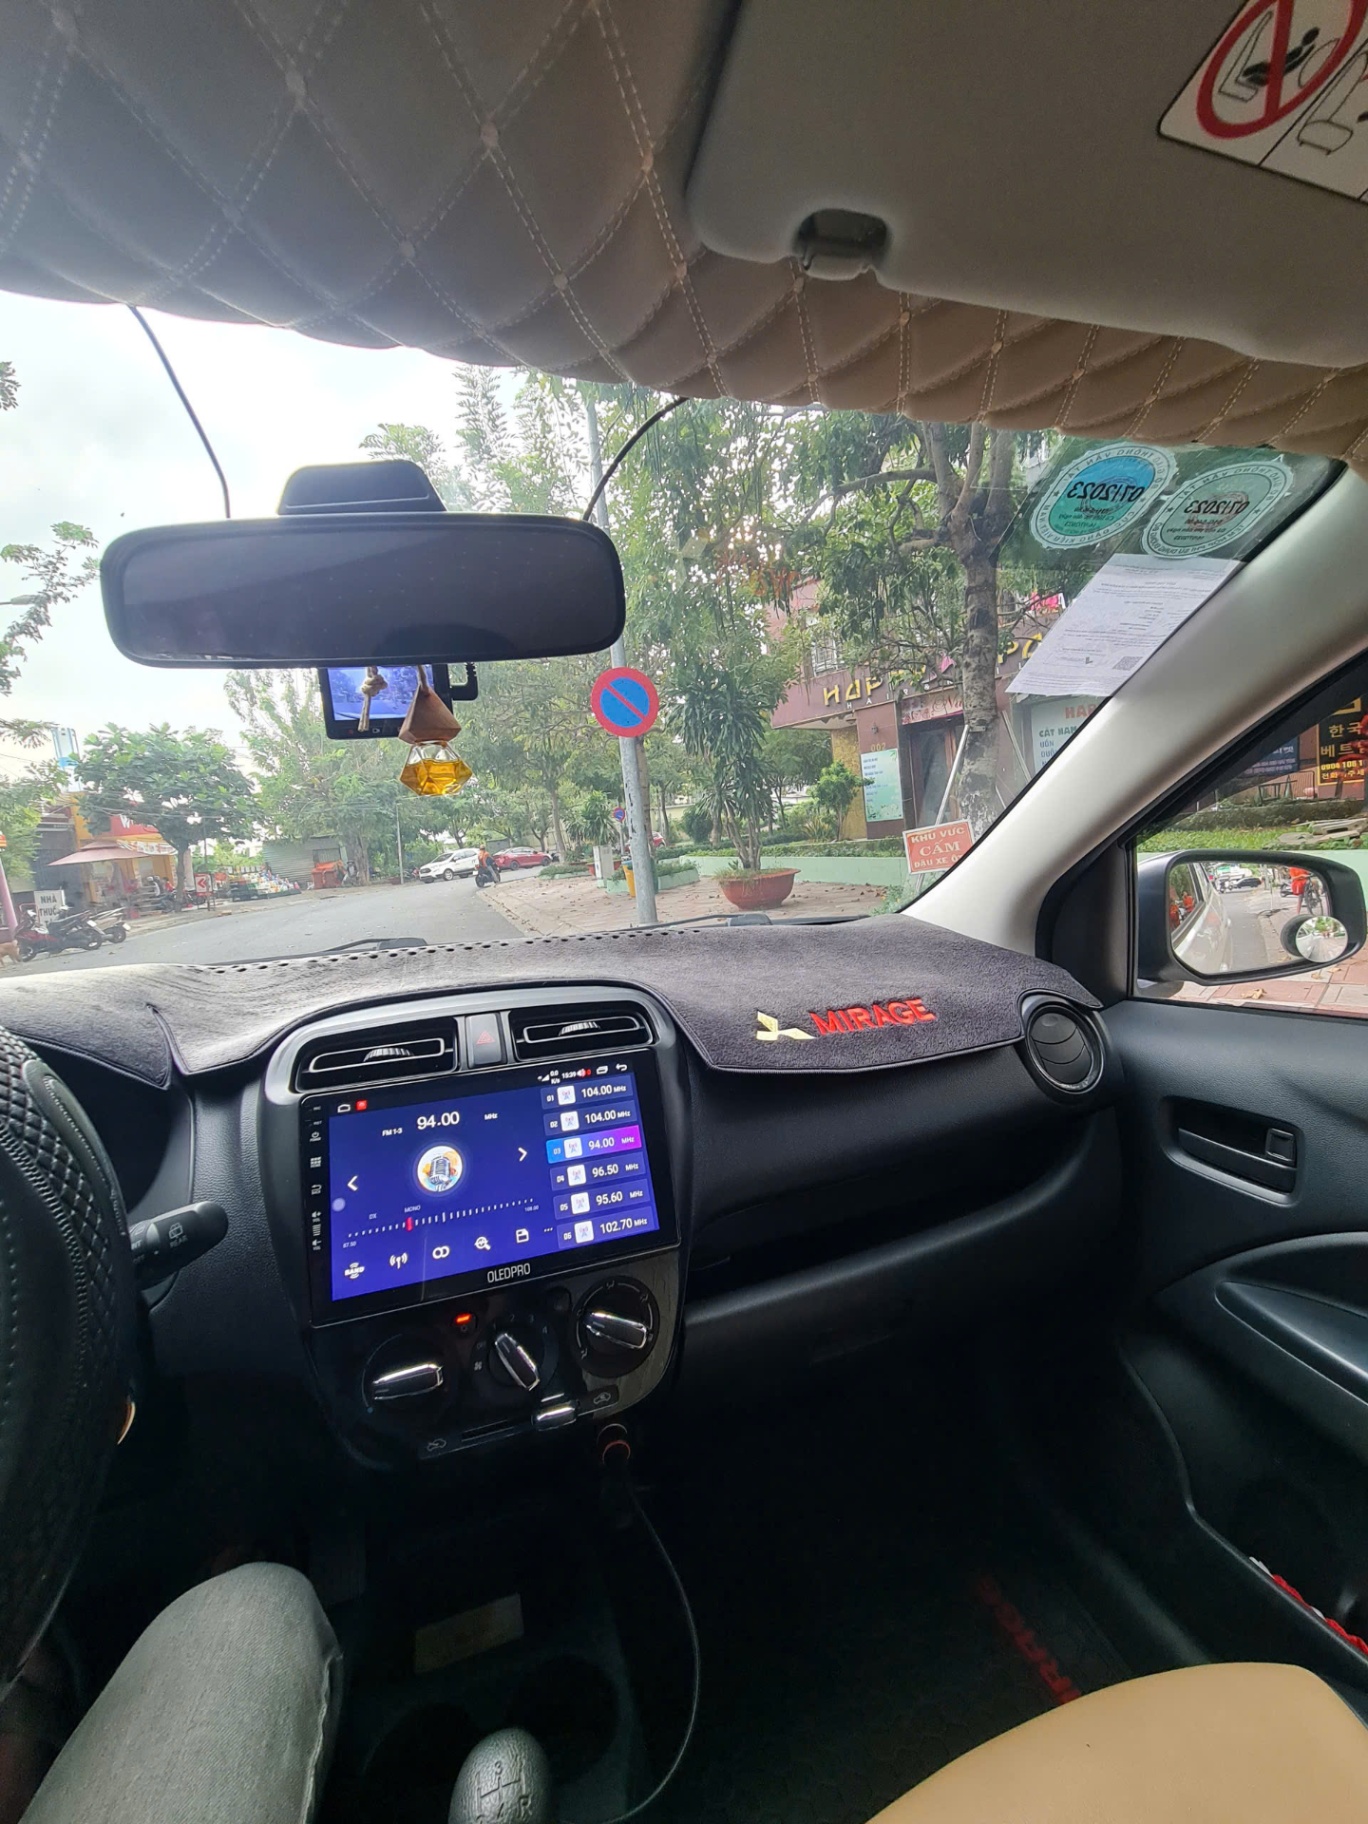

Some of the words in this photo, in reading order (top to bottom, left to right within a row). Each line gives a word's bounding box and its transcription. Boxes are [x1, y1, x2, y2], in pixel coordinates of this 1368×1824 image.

[912, 832, 936, 843] KHU
[920, 840, 960, 856] CẤM
[936, 856, 948, 864] XE
[810, 999, 936, 1036] MIRAGE
[581, 1084, 612, 1098] 104.00
[416, 1111, 460, 1130] 94.00
[584, 1110, 616, 1124] 104.00
[588, 1137, 615, 1150] 94.00
[592, 1163, 619, 1177] 96.50
[596, 1191, 623, 1206] 95.60
[600, 1218, 633, 1234] 102.70
[486, 1262, 531, 1283] OLEDPRO
[494, 1760, 503, 1775] 3
